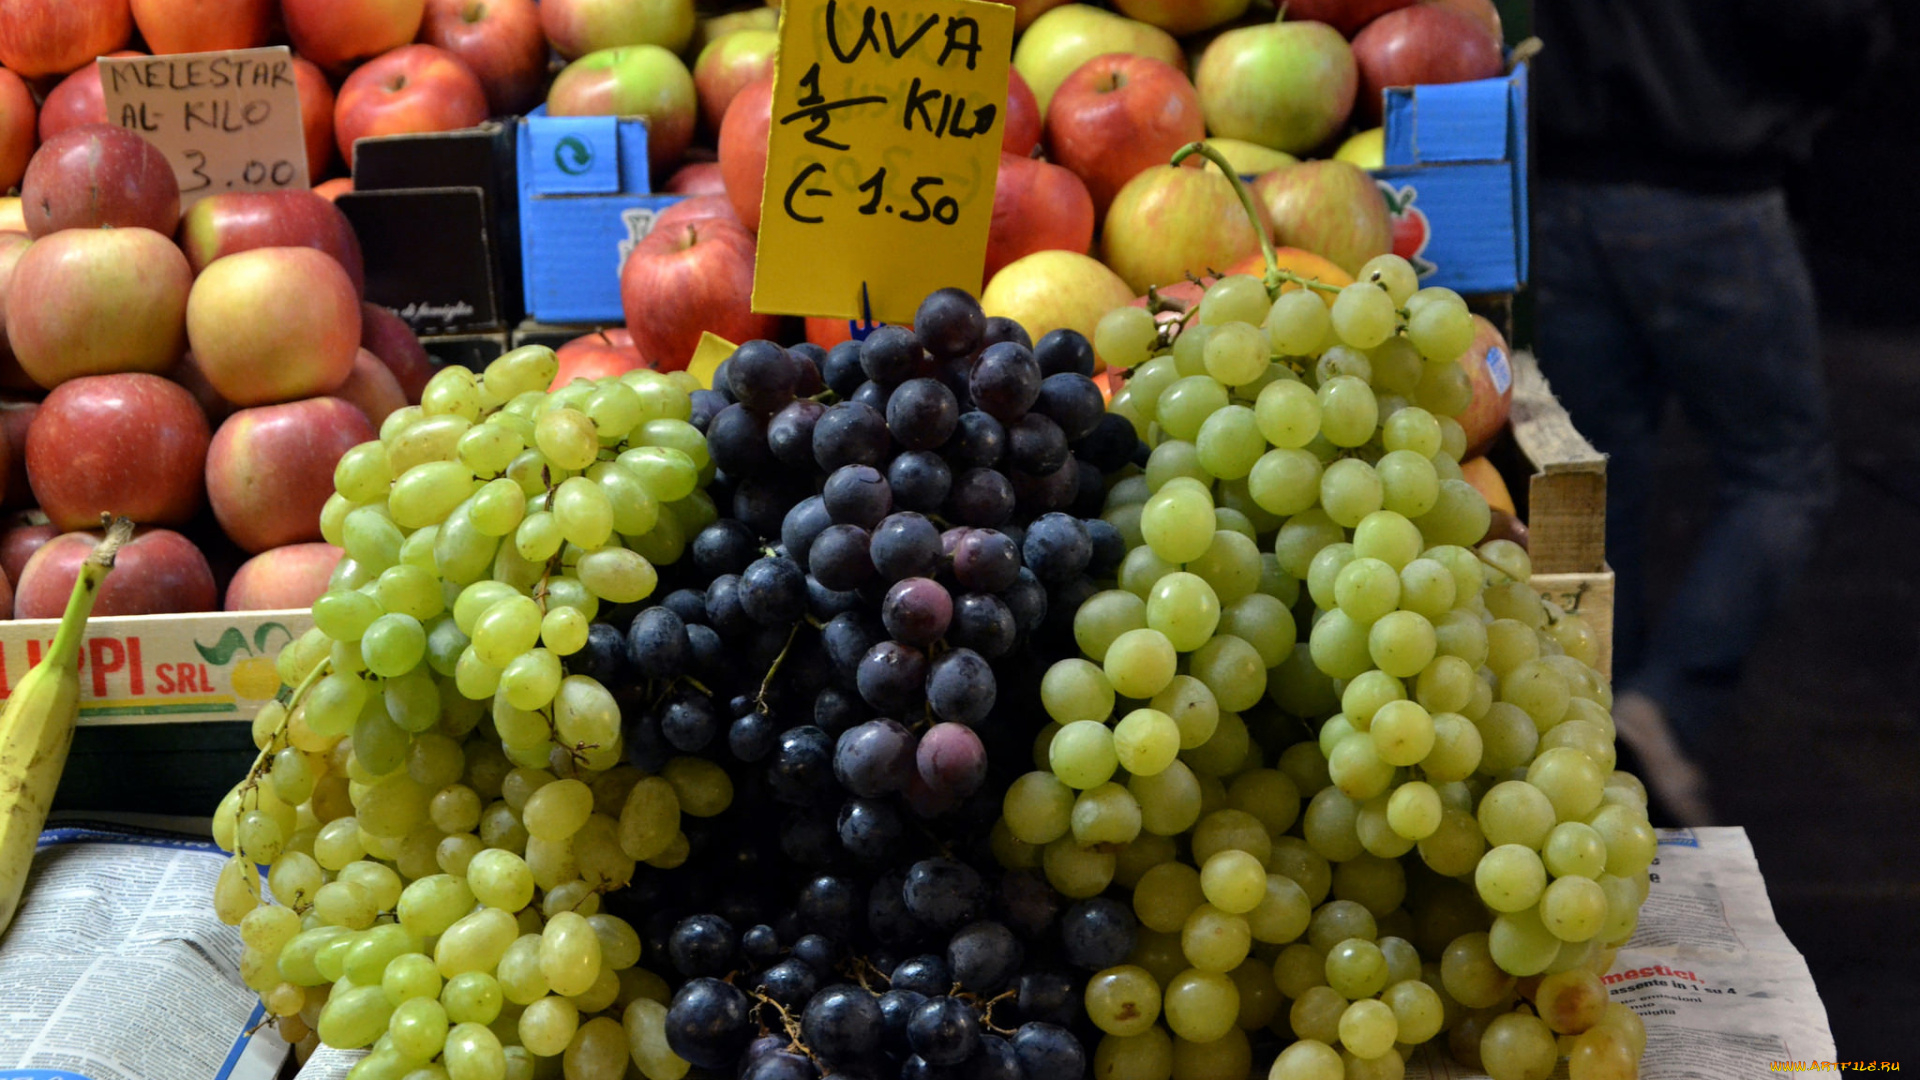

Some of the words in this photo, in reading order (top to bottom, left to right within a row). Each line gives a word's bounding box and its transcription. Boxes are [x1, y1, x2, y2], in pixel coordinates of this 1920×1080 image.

[825, 0, 982, 71] UVA
[110, 56, 294, 93] MELESTAR
[184, 100, 271, 132] KILO
[903, 77, 997, 139] KILO
[178, 150, 295, 193] 3.00
[784, 162, 833, 223] €
[858, 166, 959, 225] 1.50
[155, 662, 216, 695] SRL
[1610, 979, 1668, 996] assente
[1671, 980, 1687, 991] in
[1704, 986, 1723, 995] su
[1727, 987, 1737, 995] 4
[1640, 993, 1702, 1004] emissioni
